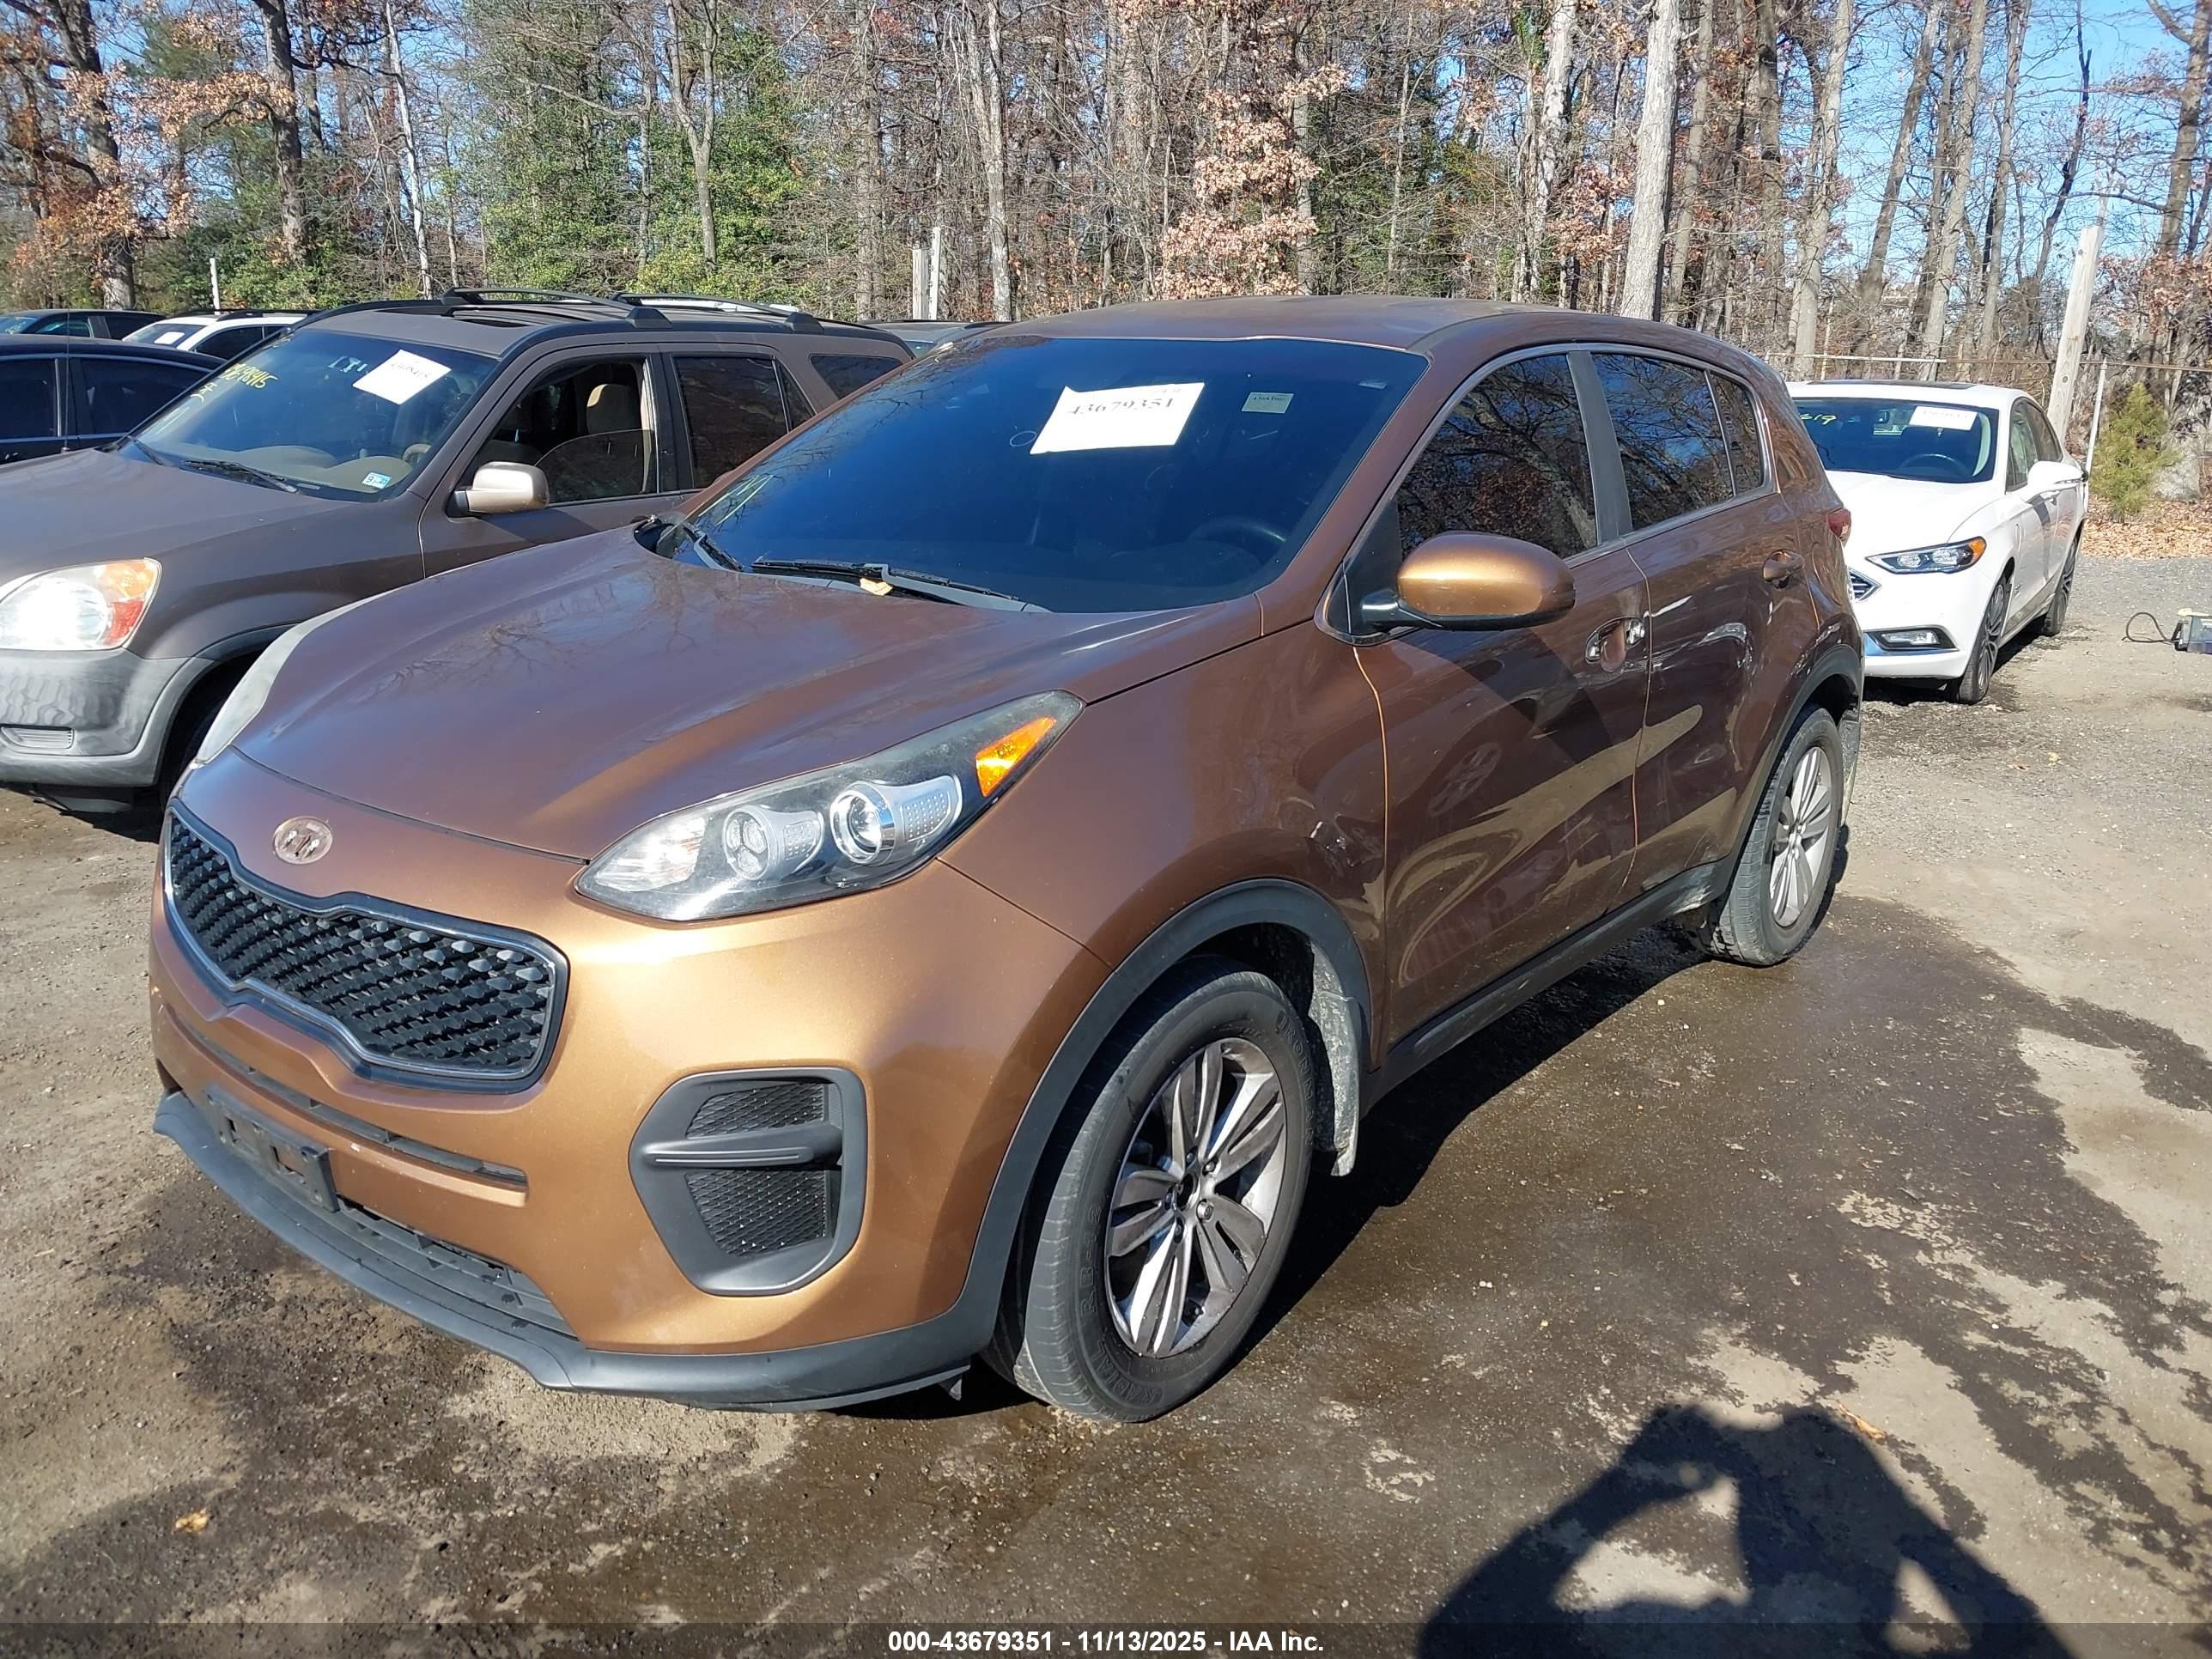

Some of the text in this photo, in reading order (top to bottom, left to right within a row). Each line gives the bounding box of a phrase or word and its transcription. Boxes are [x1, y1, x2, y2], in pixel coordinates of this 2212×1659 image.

[1069, 398, 1174, 415] 43679351
[1277, 1015, 1314, 1146] IRONMAN
[1091, 1338, 1159, 1405] RADIAL
